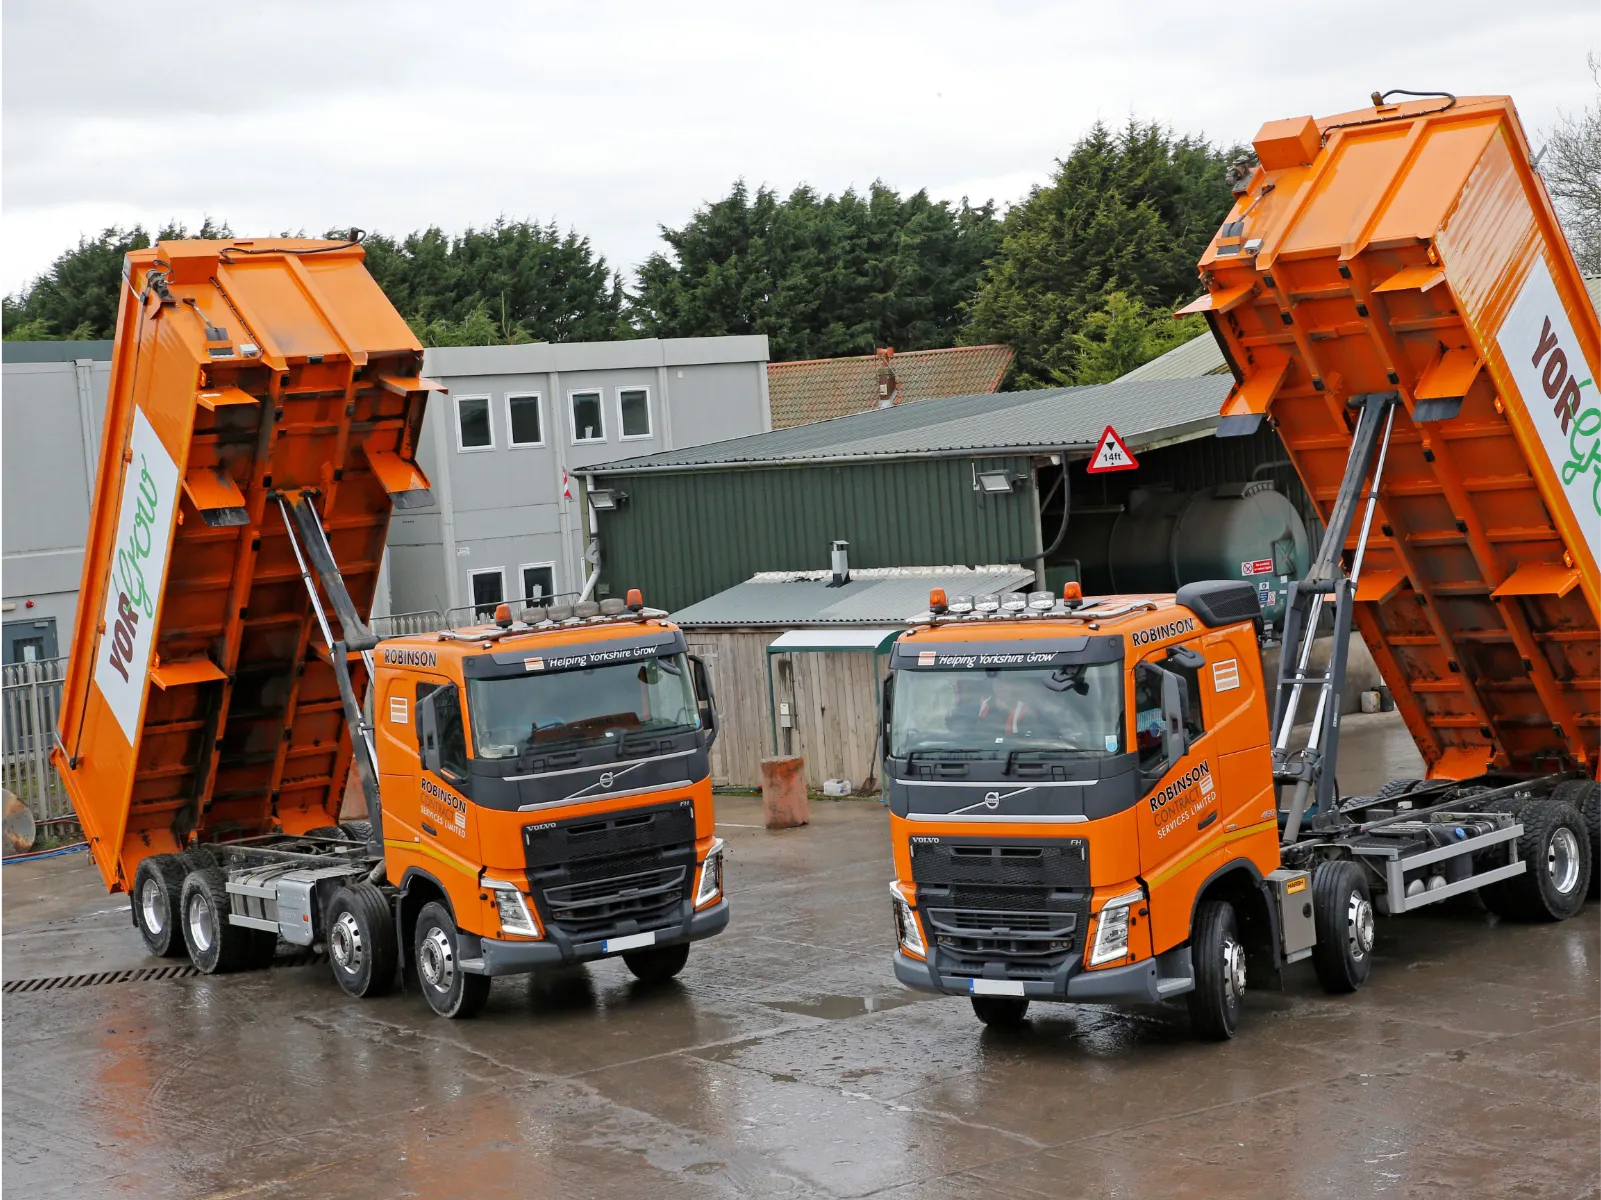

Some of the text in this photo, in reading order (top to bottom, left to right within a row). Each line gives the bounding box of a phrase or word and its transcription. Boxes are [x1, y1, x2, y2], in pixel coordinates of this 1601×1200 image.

[1103, 453, 1121, 462] 14ft
[1132, 618, 1194, 647] ROBINSON
[384, 648, 437, 668] ROBINSON
[589, 648, 631, 662] Yorkshire
[979, 653, 1024, 664] Yorkshire
[421, 776, 467, 815] ROBINSON
[1148, 760, 1210, 813] ROBINSON
[1153, 787, 1200, 827] CONTRACT
[1157, 791, 1217, 839] SERVICES LIMITED
[420, 805, 466, 839] SERVICES LIMITED
[526, 822, 557, 831] VOLVO
[1287, 879, 1304, 889] HARSH
